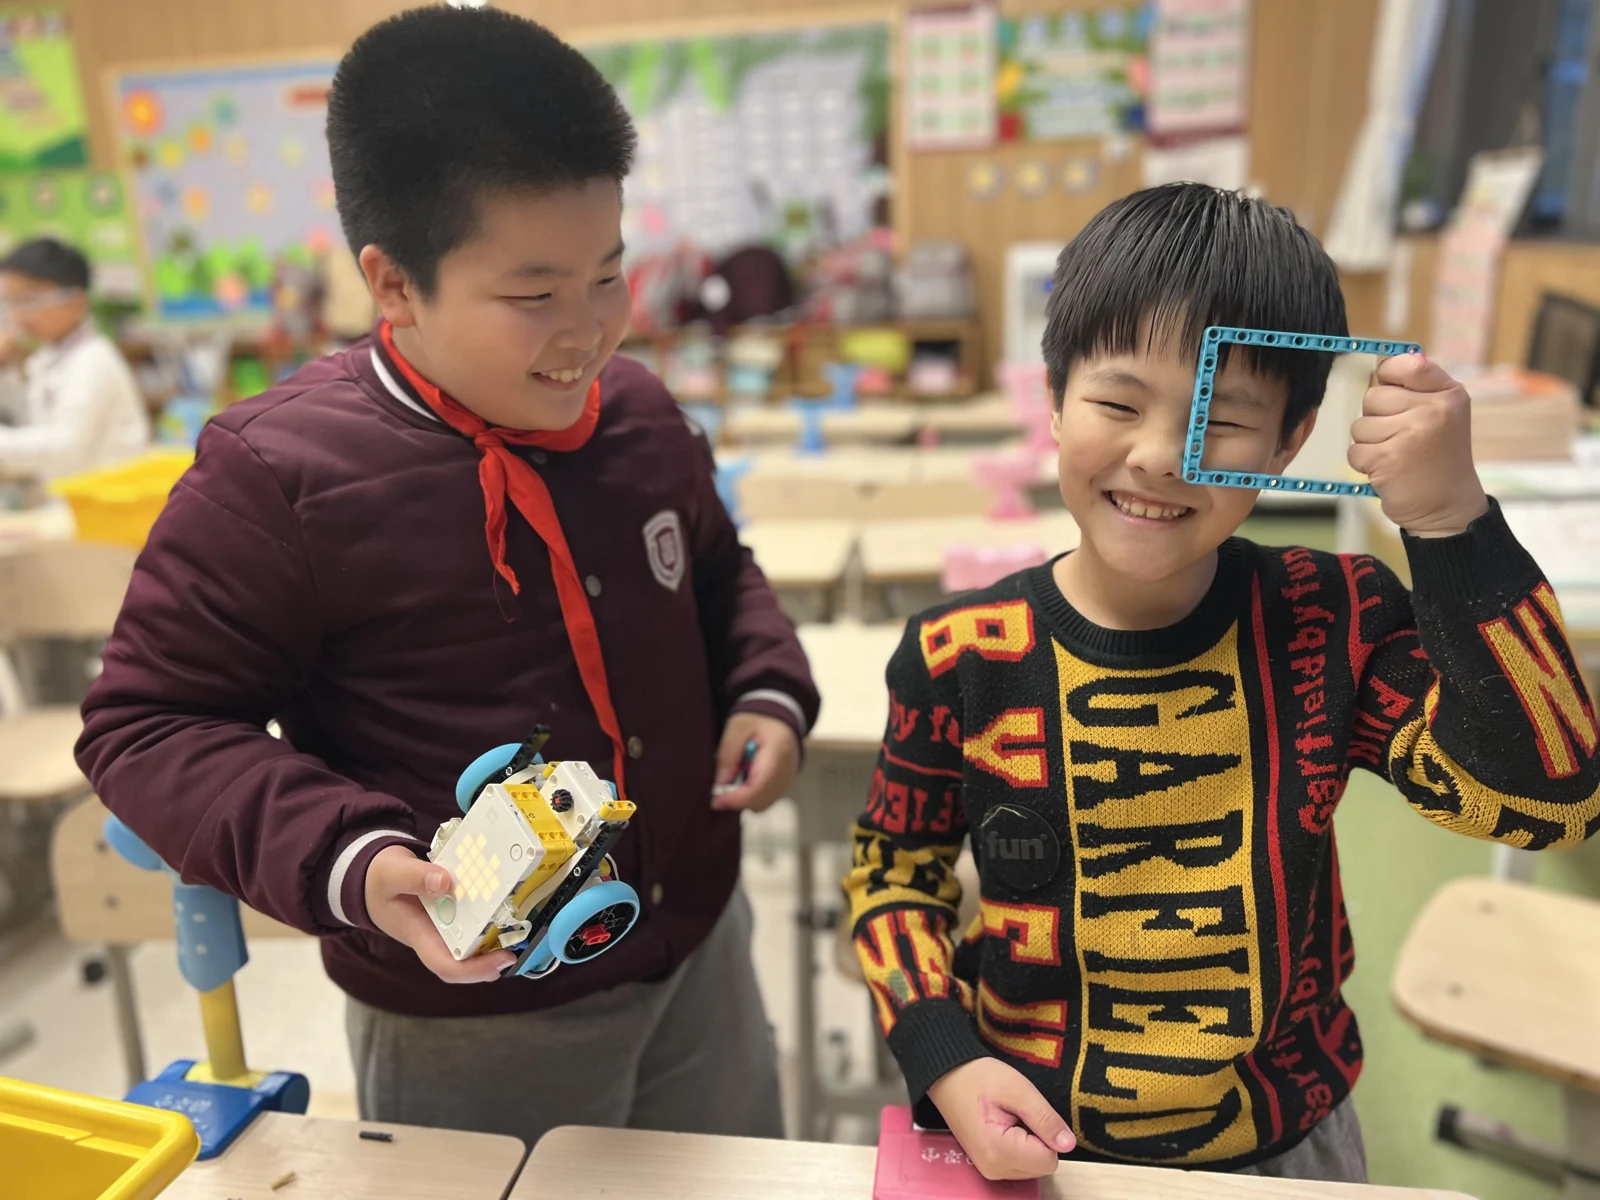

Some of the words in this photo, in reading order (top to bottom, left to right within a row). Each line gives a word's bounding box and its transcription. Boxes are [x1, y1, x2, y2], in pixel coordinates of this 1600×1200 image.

[919, 598, 1048, 788] BY
[986, 831, 1047, 861] fun
[1066, 669, 1252, 1161] GARFIELD
